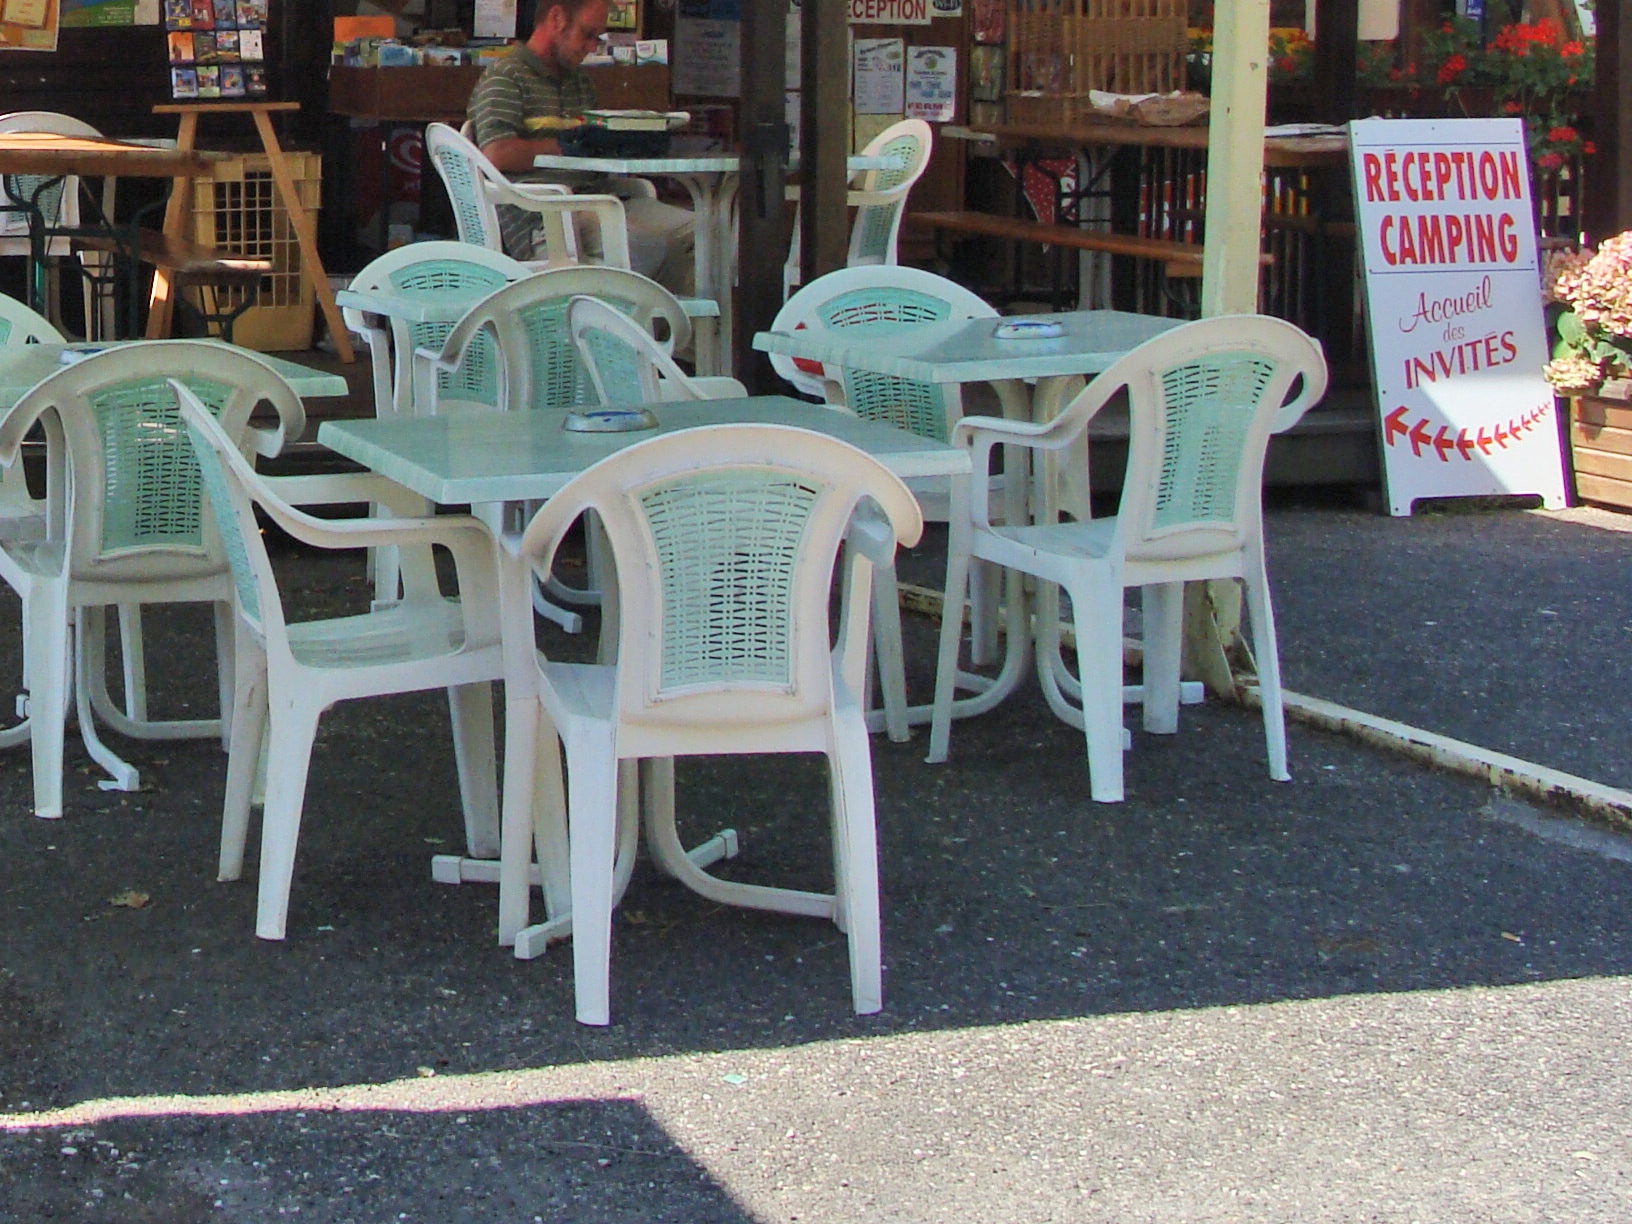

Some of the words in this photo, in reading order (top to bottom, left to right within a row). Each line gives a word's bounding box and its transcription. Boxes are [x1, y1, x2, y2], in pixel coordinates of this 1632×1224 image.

[1380, 212, 1518, 266] CAMPING
[1399, 275, 1494, 333] Accueil
[1442, 322, 1466, 342] des
